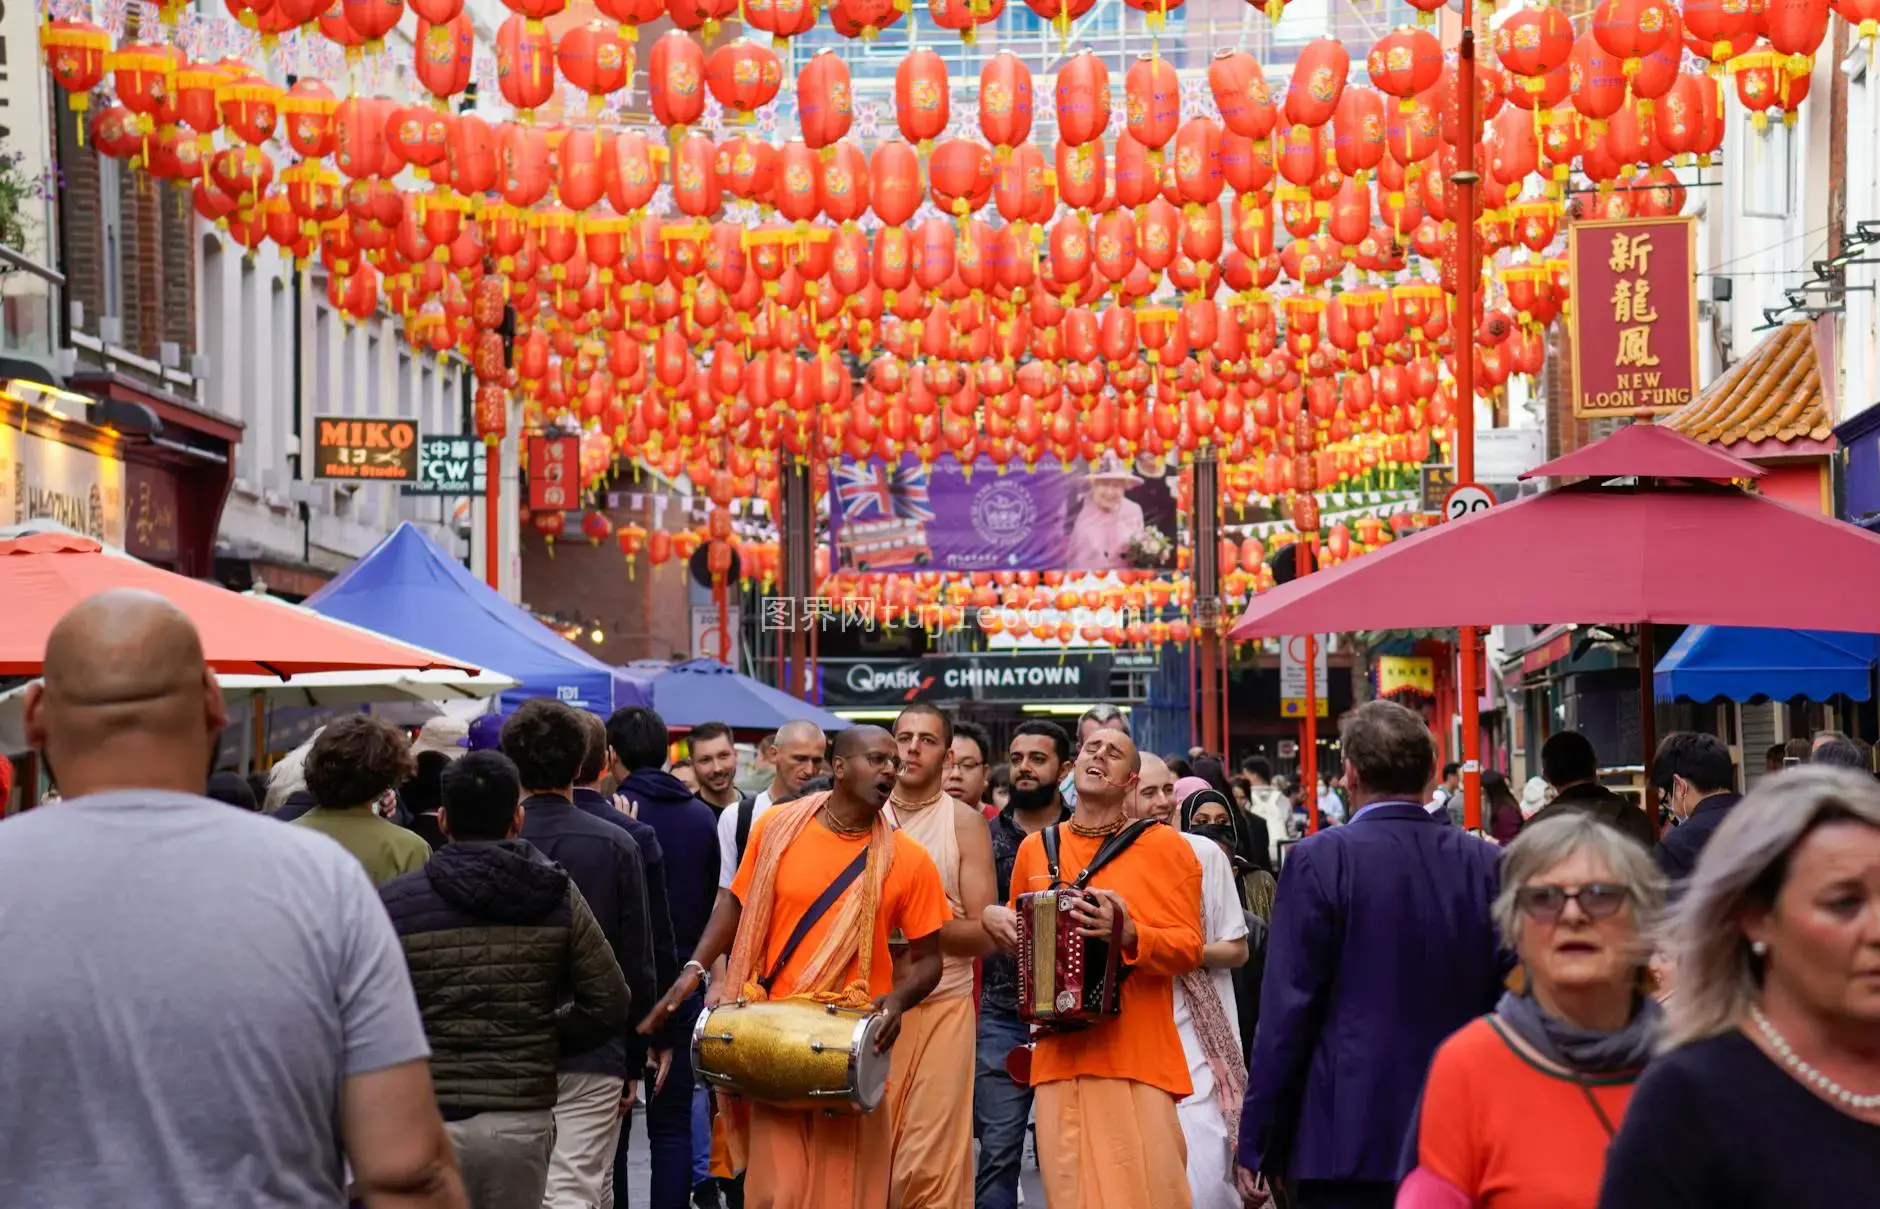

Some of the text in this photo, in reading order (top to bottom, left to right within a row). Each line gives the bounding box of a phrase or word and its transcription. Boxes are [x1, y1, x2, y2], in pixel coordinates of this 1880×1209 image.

[1608, 232, 1661, 367] 新龍鳳
[1617, 371, 1662, 389] NEW
[1583, 387, 1690, 408] LOON FUNG
[320, 420, 414, 449] MIKO
[325, 464, 407, 478] Hair Studio
[438, 479, 470, 492] Salon
[944, 666, 1080, 688] CHINATOWN
